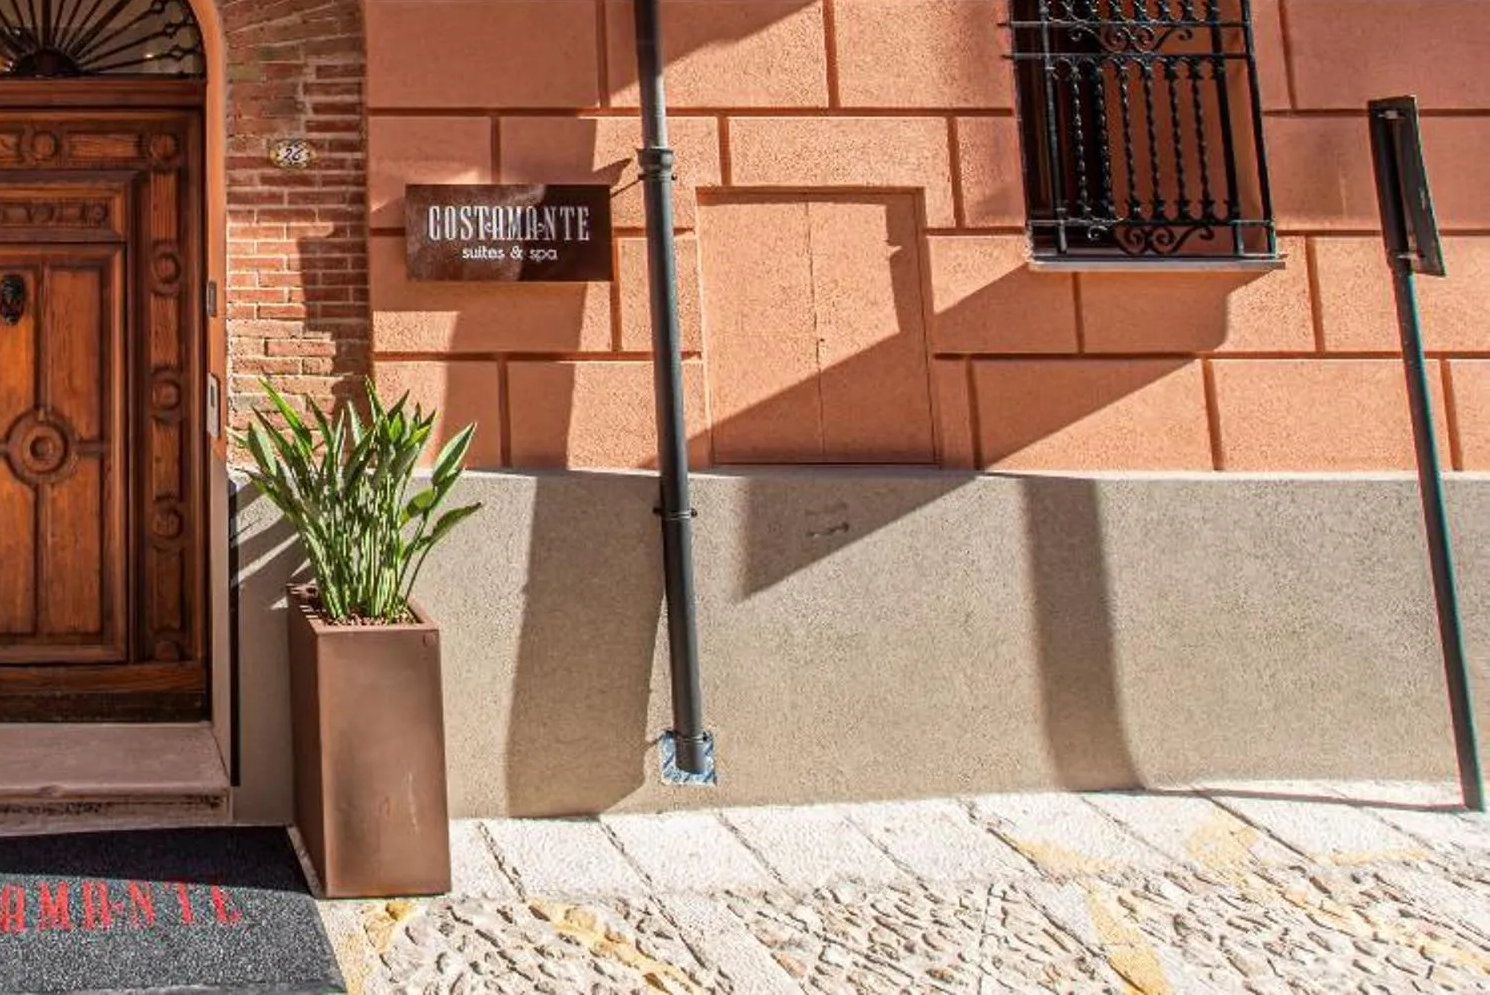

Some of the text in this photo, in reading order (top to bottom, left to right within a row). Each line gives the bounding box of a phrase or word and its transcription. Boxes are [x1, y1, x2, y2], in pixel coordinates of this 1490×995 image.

[284, 147, 304, 161] 26
[428, 205, 590, 241] COSTAMANTE
[462, 245, 558, 264] suites & spa
